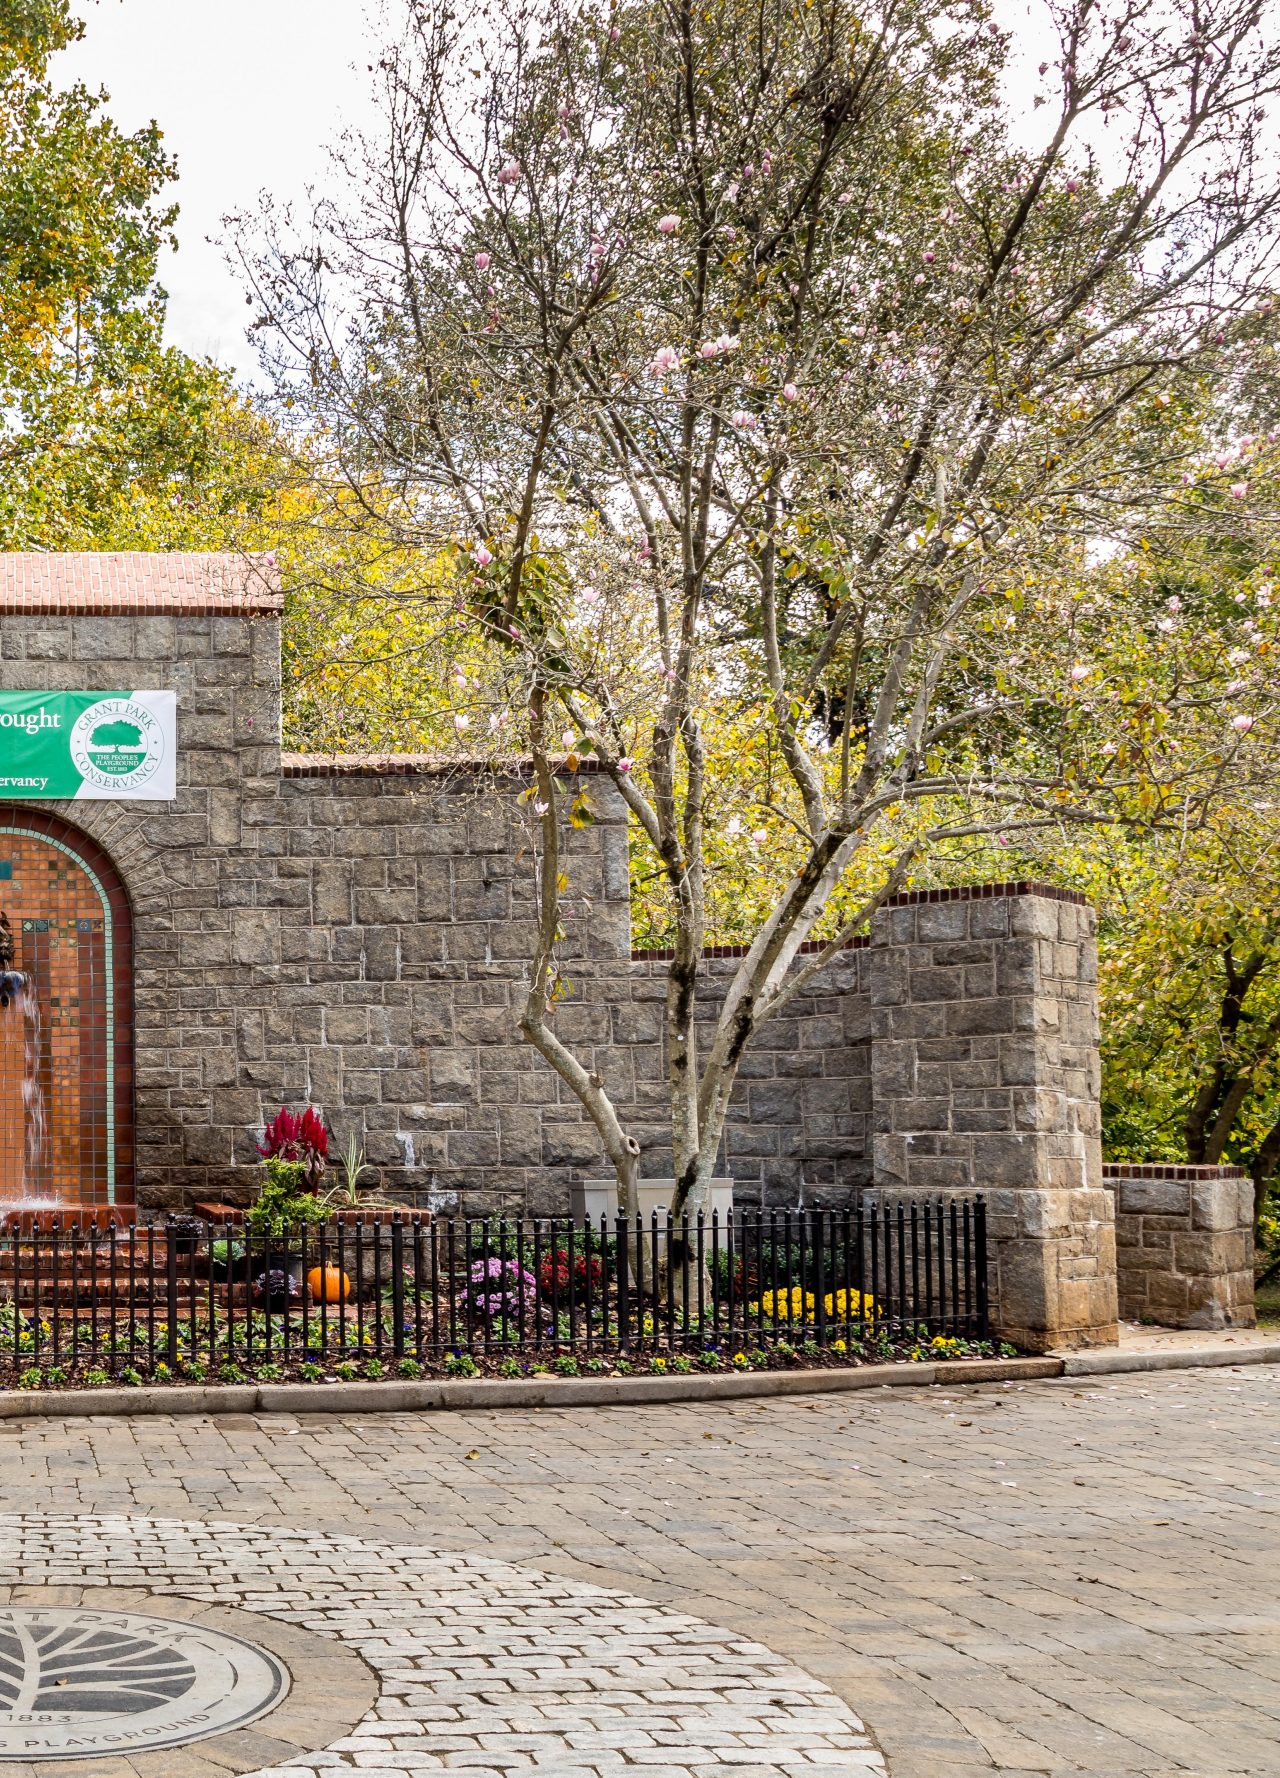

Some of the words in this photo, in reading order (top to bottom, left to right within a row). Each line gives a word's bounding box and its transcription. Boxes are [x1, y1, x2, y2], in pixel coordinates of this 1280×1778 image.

[77, 701, 122, 731] GRANT
[125, 703, 156, 730] PARK
[75, 752, 159, 788] CONSERVANCY
[72, 1614, 201, 1643] PARK
[8, 1714, 71, 1723] 1883
[24, 1714, 210, 1748] PLAYGROUND
